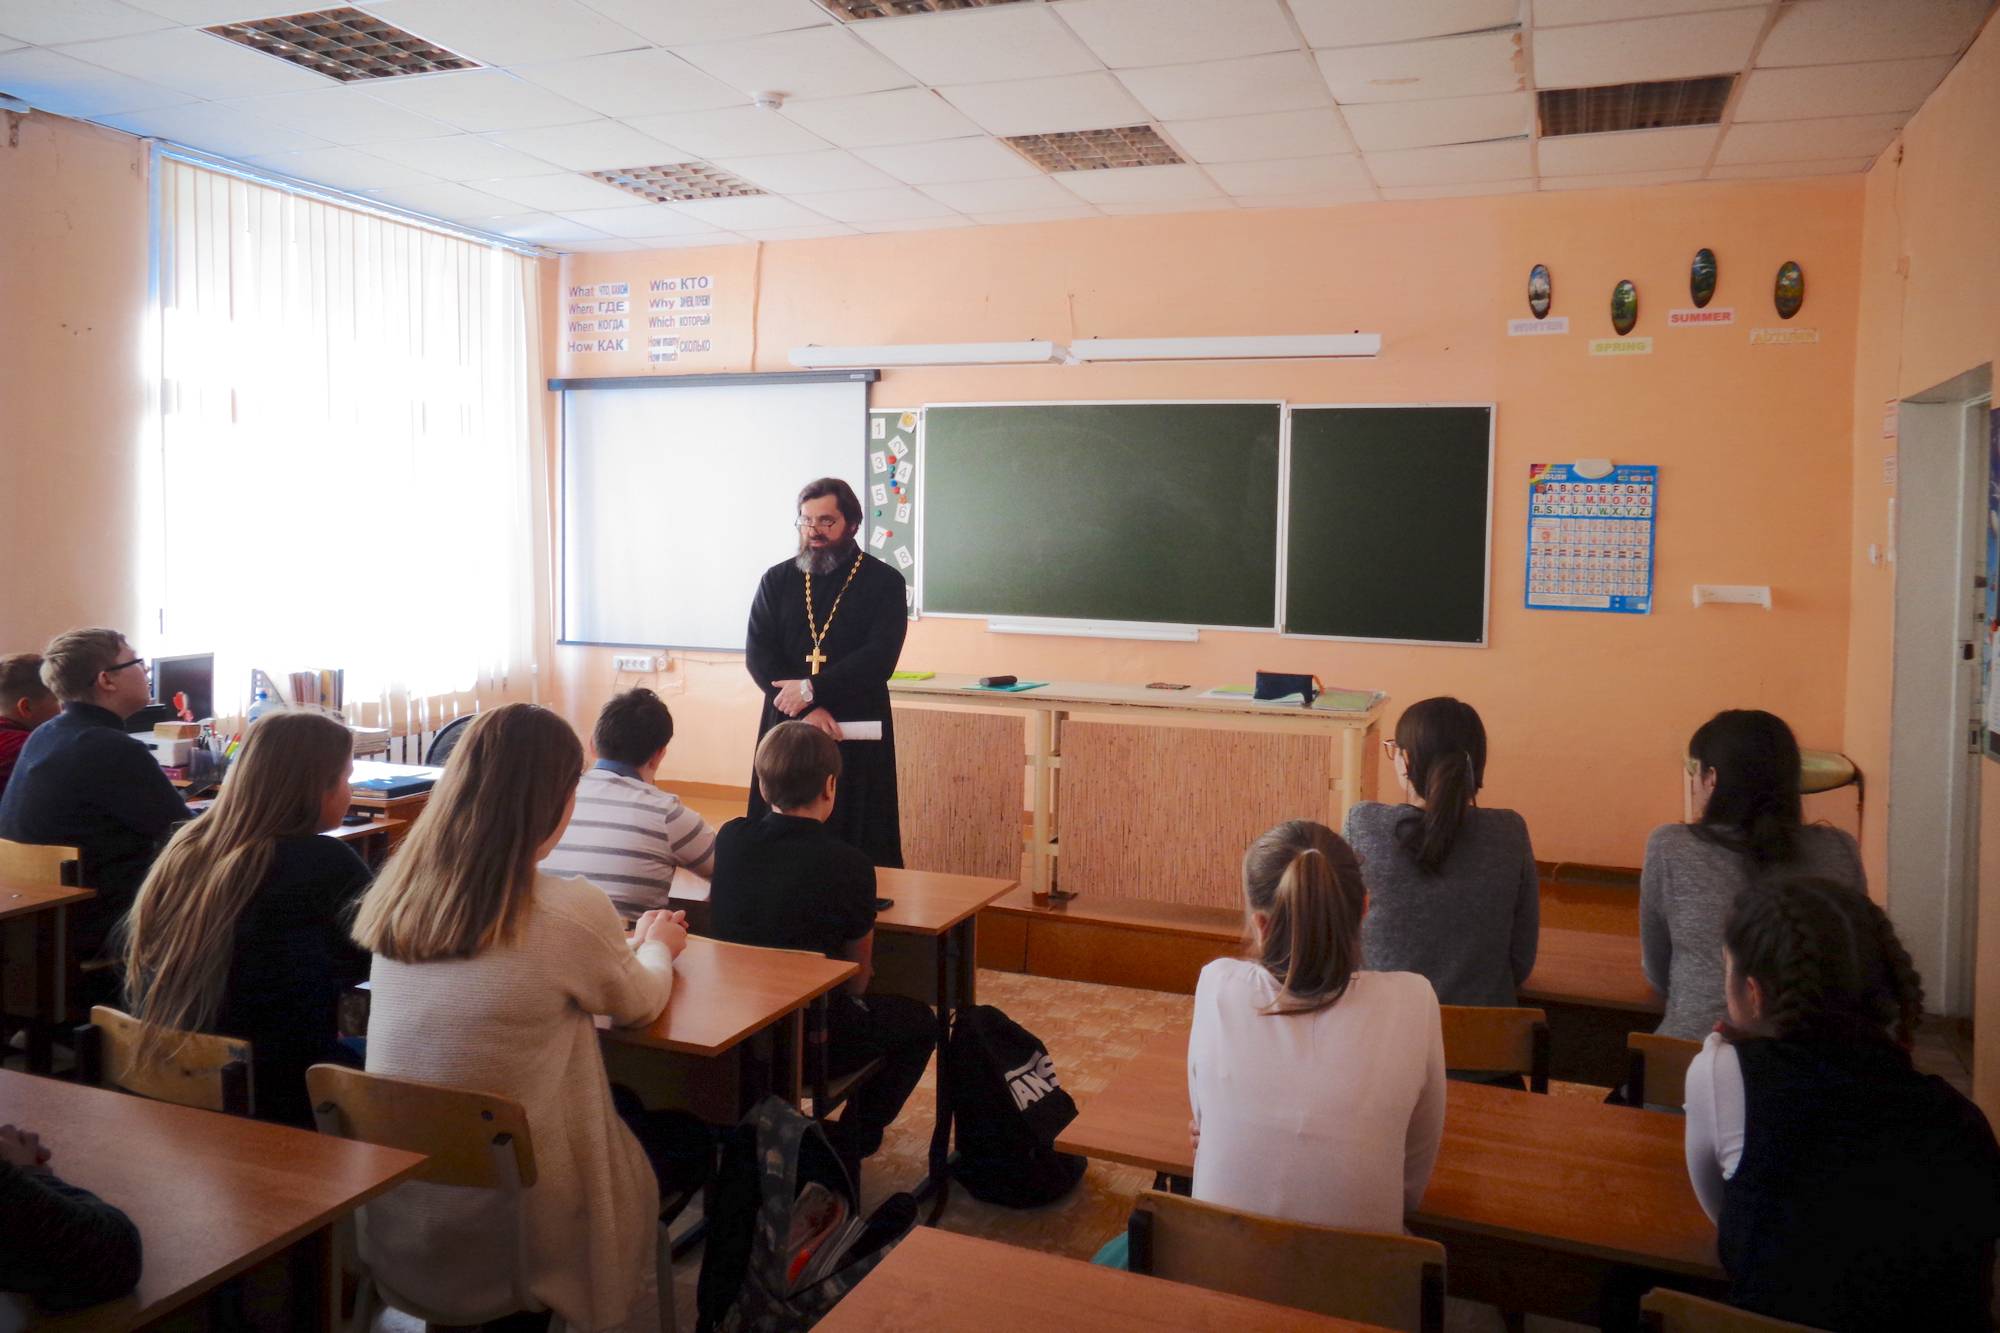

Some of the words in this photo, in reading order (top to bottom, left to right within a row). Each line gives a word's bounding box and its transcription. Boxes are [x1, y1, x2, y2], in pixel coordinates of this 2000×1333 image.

[650, 280, 676, 291] Who
[681, 277, 708, 290] КТО
[569, 287, 594, 297] What
[569, 303, 594, 314] Where
[599, 302, 624, 313] ГДЕ
[650, 299, 675, 309] Why
[649, 316, 675, 328] Which
[680, 314, 710, 326] КОТОРЫЙ
[1671, 312, 1731, 323] SUMMER
[569, 321, 594, 332] When
[598, 319, 623, 331] КОГДА
[1513, 321, 1563, 332] WINTER
[568, 342, 593, 352] How
[598, 340, 623, 351] КАК
[648, 336, 661, 347] How
[663, 337, 679, 348] many
[680, 340, 710, 352] СКОЛЬКО
[1595, 342, 1646, 352] SPRING
[648, 351, 660, 362] How
[662, 351, 678, 362] much
[875, 424, 880, 435] 1
[894, 441, 905, 454] 2
[875, 457, 884, 469] 3
[899, 467, 907, 479] 4
[875, 489, 884, 501] 5
[899, 506, 907, 518] 6
[876, 532, 884, 543] 7
[900, 551, 910, 563] 8
